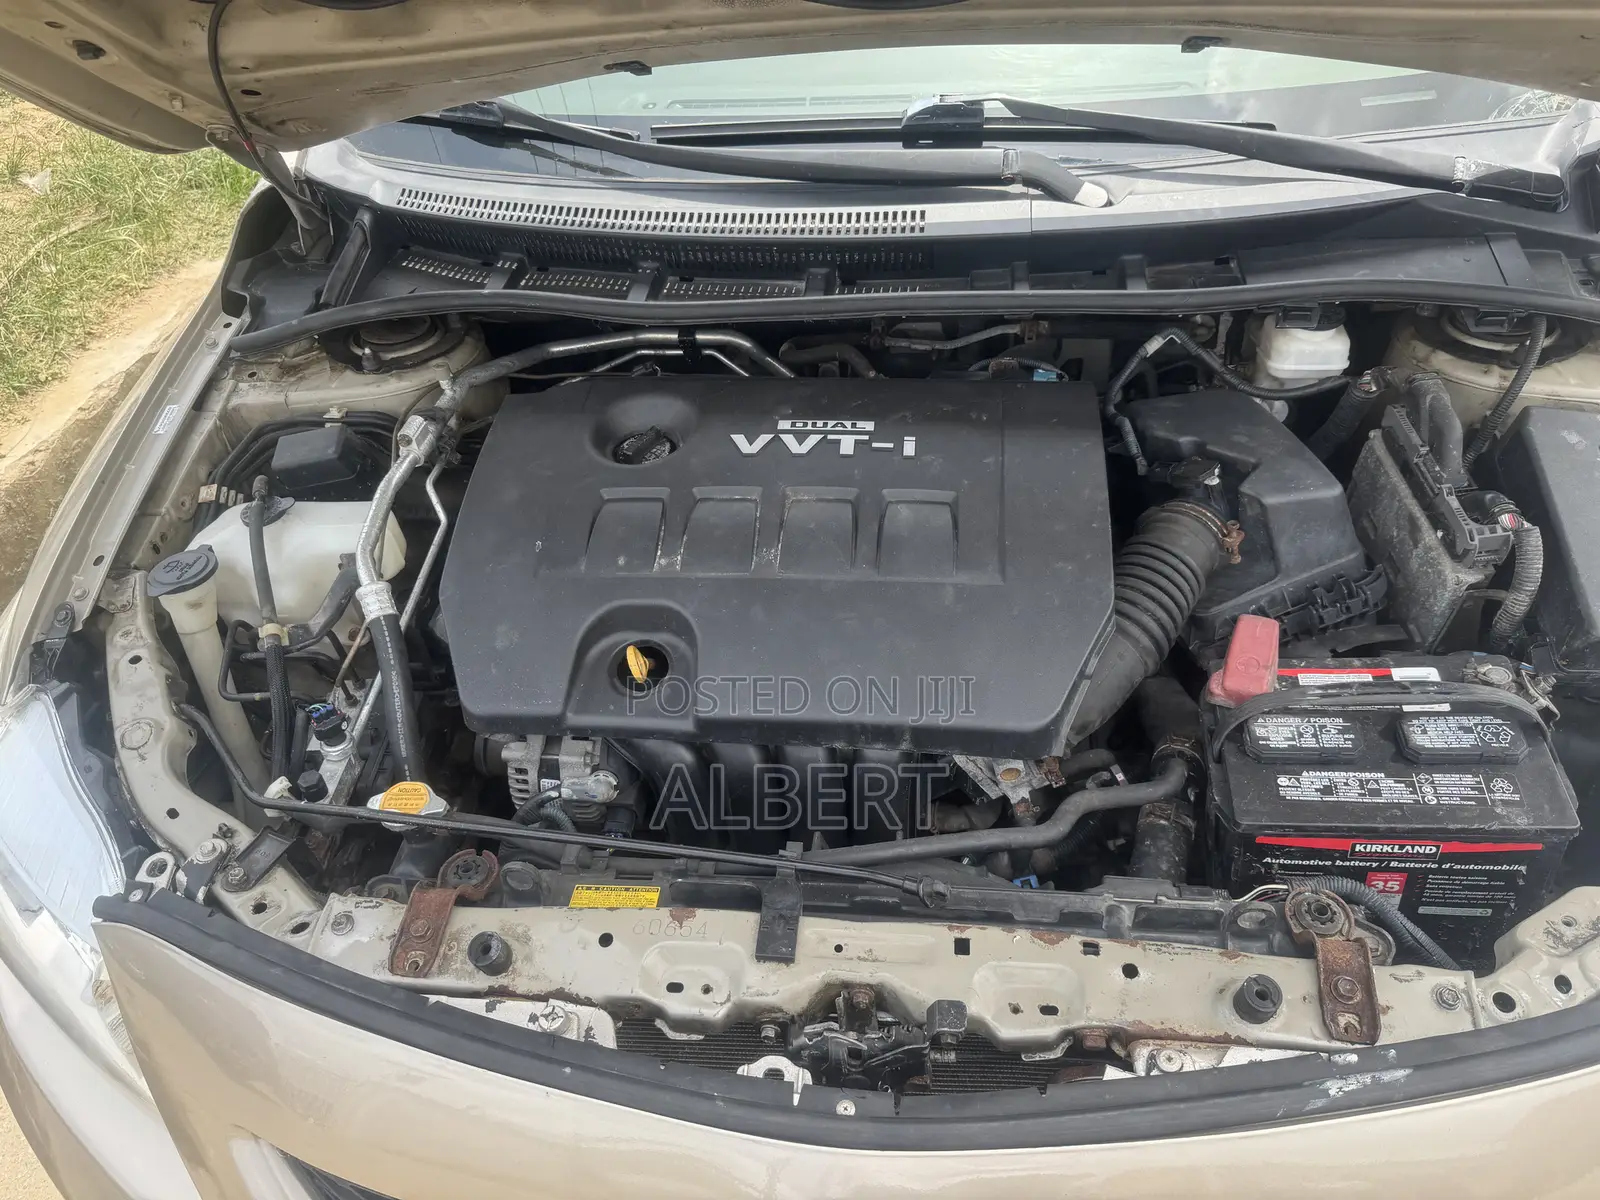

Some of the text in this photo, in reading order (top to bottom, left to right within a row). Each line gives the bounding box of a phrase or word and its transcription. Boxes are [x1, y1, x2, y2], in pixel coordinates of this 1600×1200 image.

[789, 420, 867, 430] DUAL
[730, 434, 917, 457] VVT-i
[1308, 770, 1385, 778] DANGER/POISON
[1354, 844, 1437, 854] KIRKLAND
[1262, 857, 1332, 866] Automotive
[1335, 858, 1380, 868] battery
[1389, 861, 1439, 869] Batterie
[1371, 881, 1400, 892] 35
